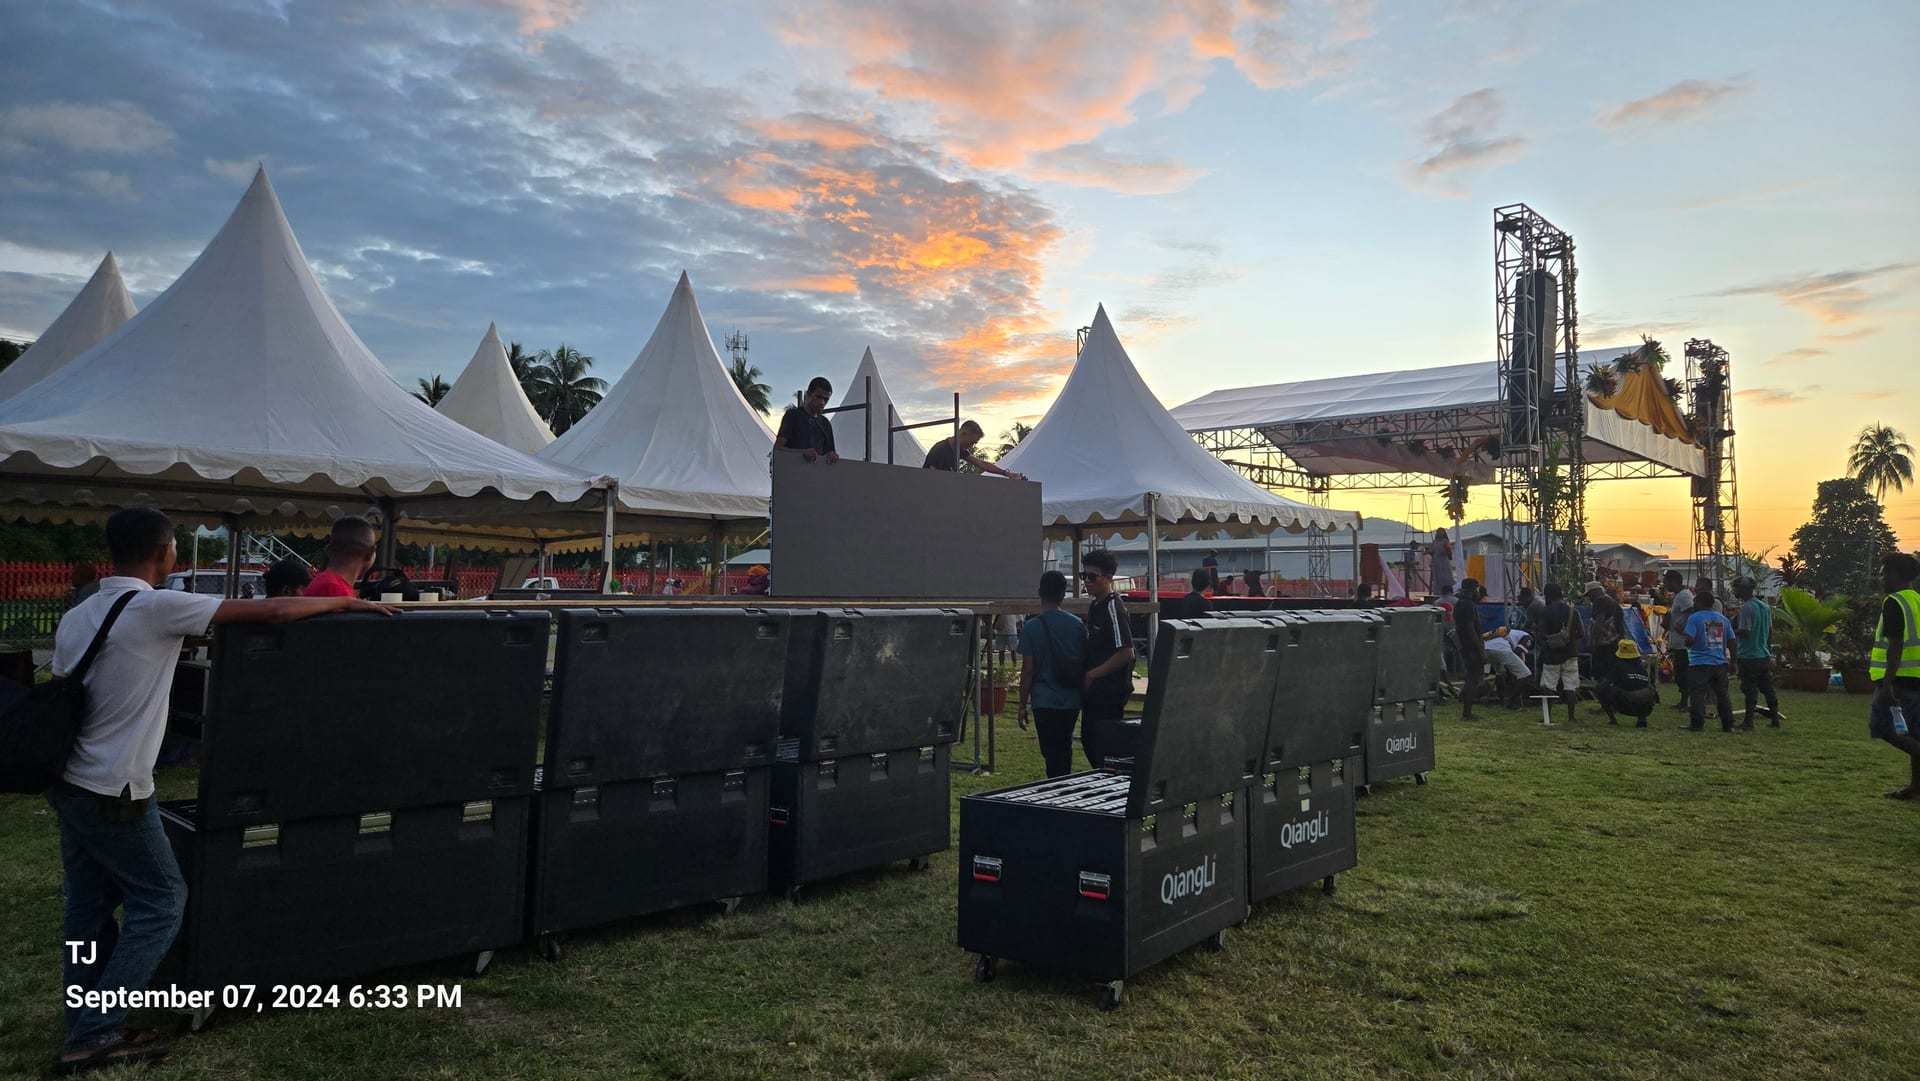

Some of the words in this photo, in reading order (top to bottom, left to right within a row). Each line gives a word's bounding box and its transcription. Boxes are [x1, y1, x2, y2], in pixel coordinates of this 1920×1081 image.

[1386, 732, 1417, 754] QiangLi
[1281, 810, 1329, 849] QiangLi
[1161, 853, 1217, 905] QiangLi
